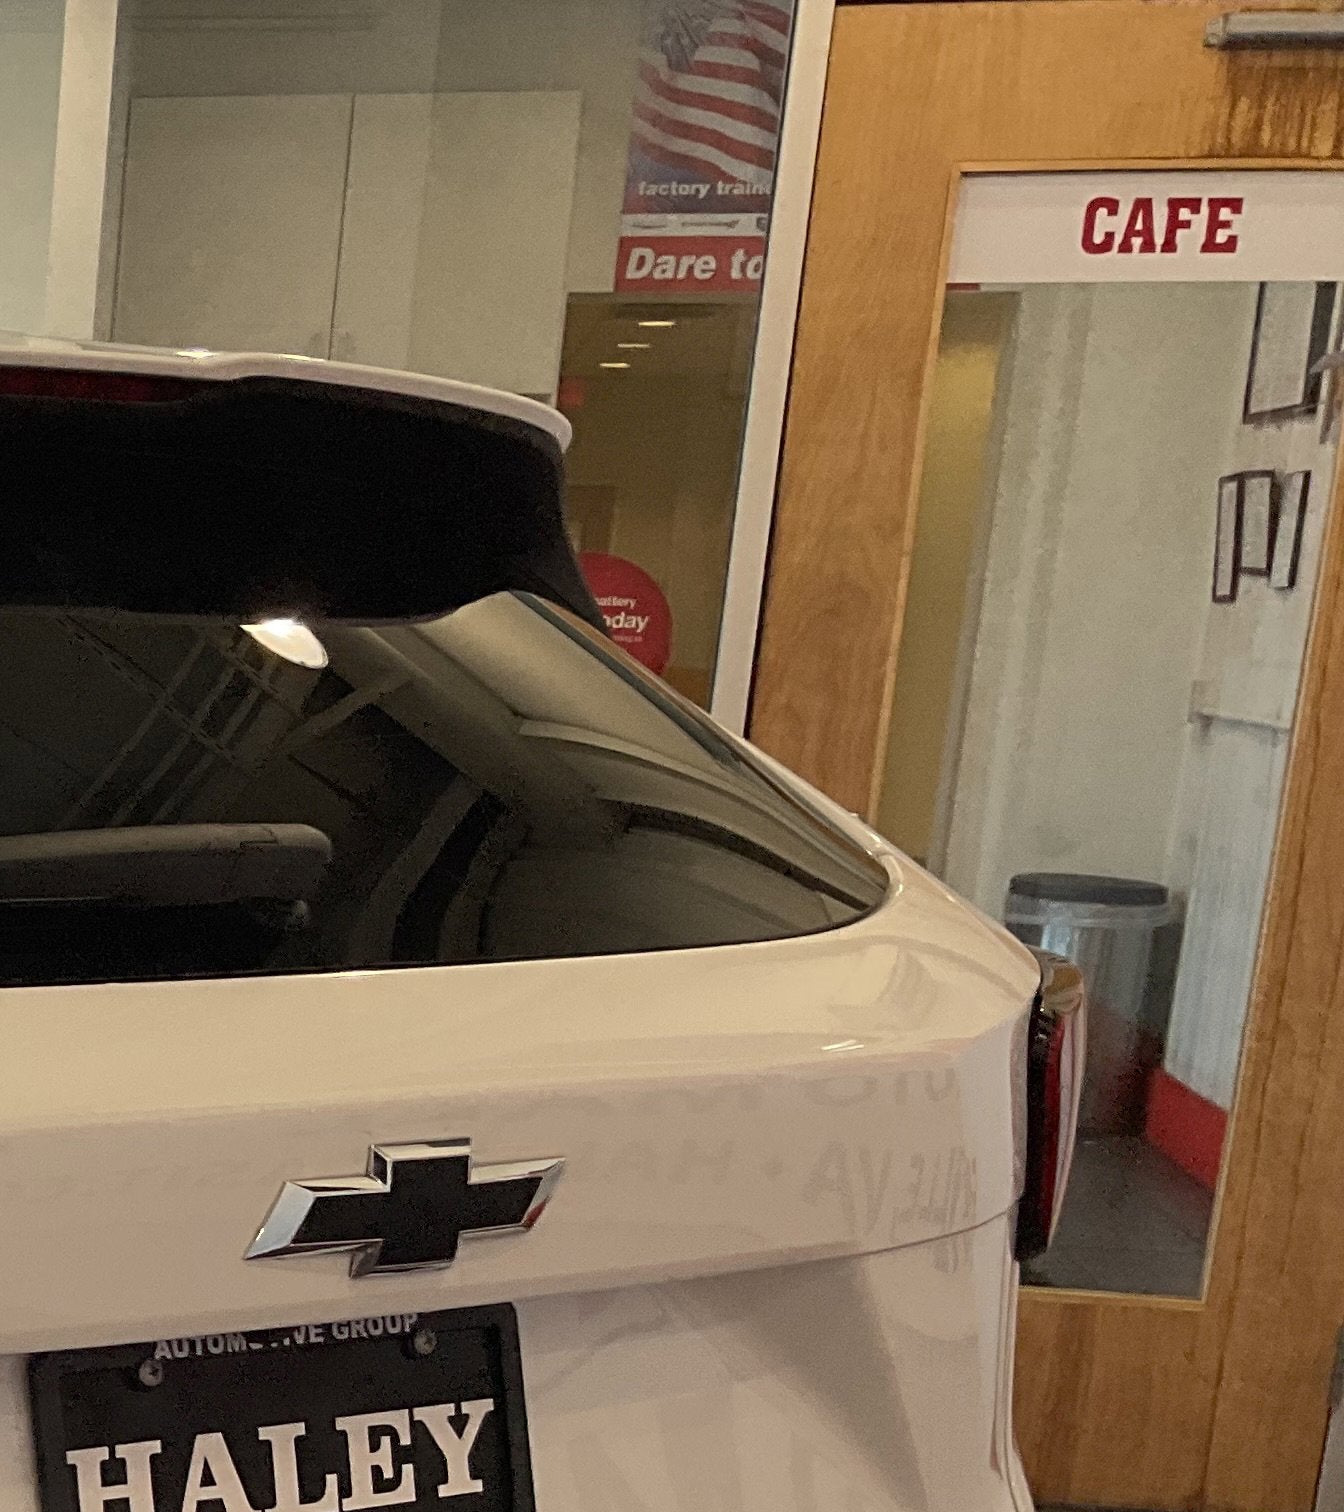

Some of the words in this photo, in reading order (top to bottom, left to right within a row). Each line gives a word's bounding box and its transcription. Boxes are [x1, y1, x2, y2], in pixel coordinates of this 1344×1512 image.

[638, 178, 710, 199] factory
[1081, 197, 1244, 254] CAFE
[625, 247, 717, 280] Dare
[331, 1311, 419, 1341] GROUP
